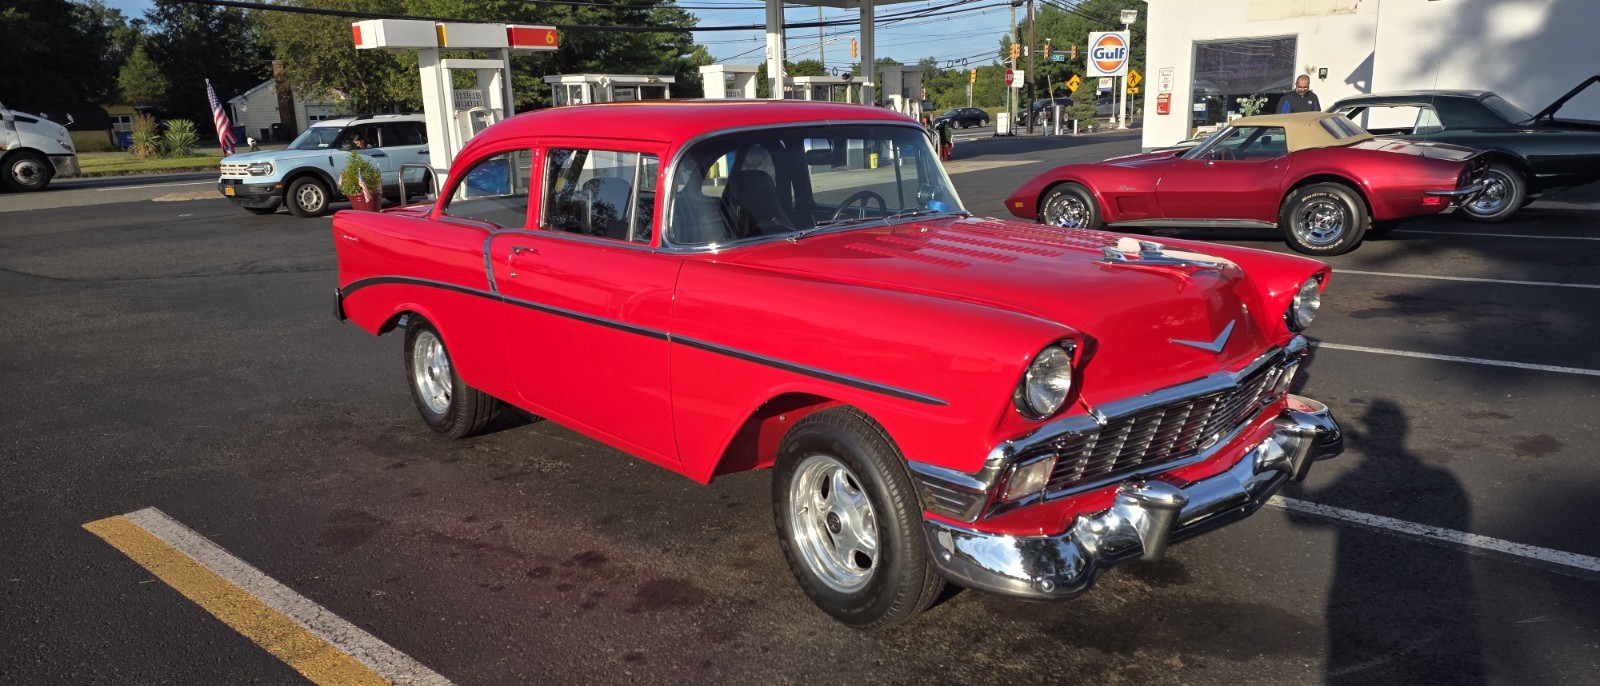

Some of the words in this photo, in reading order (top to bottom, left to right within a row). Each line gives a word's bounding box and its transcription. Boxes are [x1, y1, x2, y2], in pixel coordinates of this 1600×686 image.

[546, 31, 554, 44] 6
[1094, 47, 1125, 59] Gulf
[1302, 193, 1326, 202] Radial
